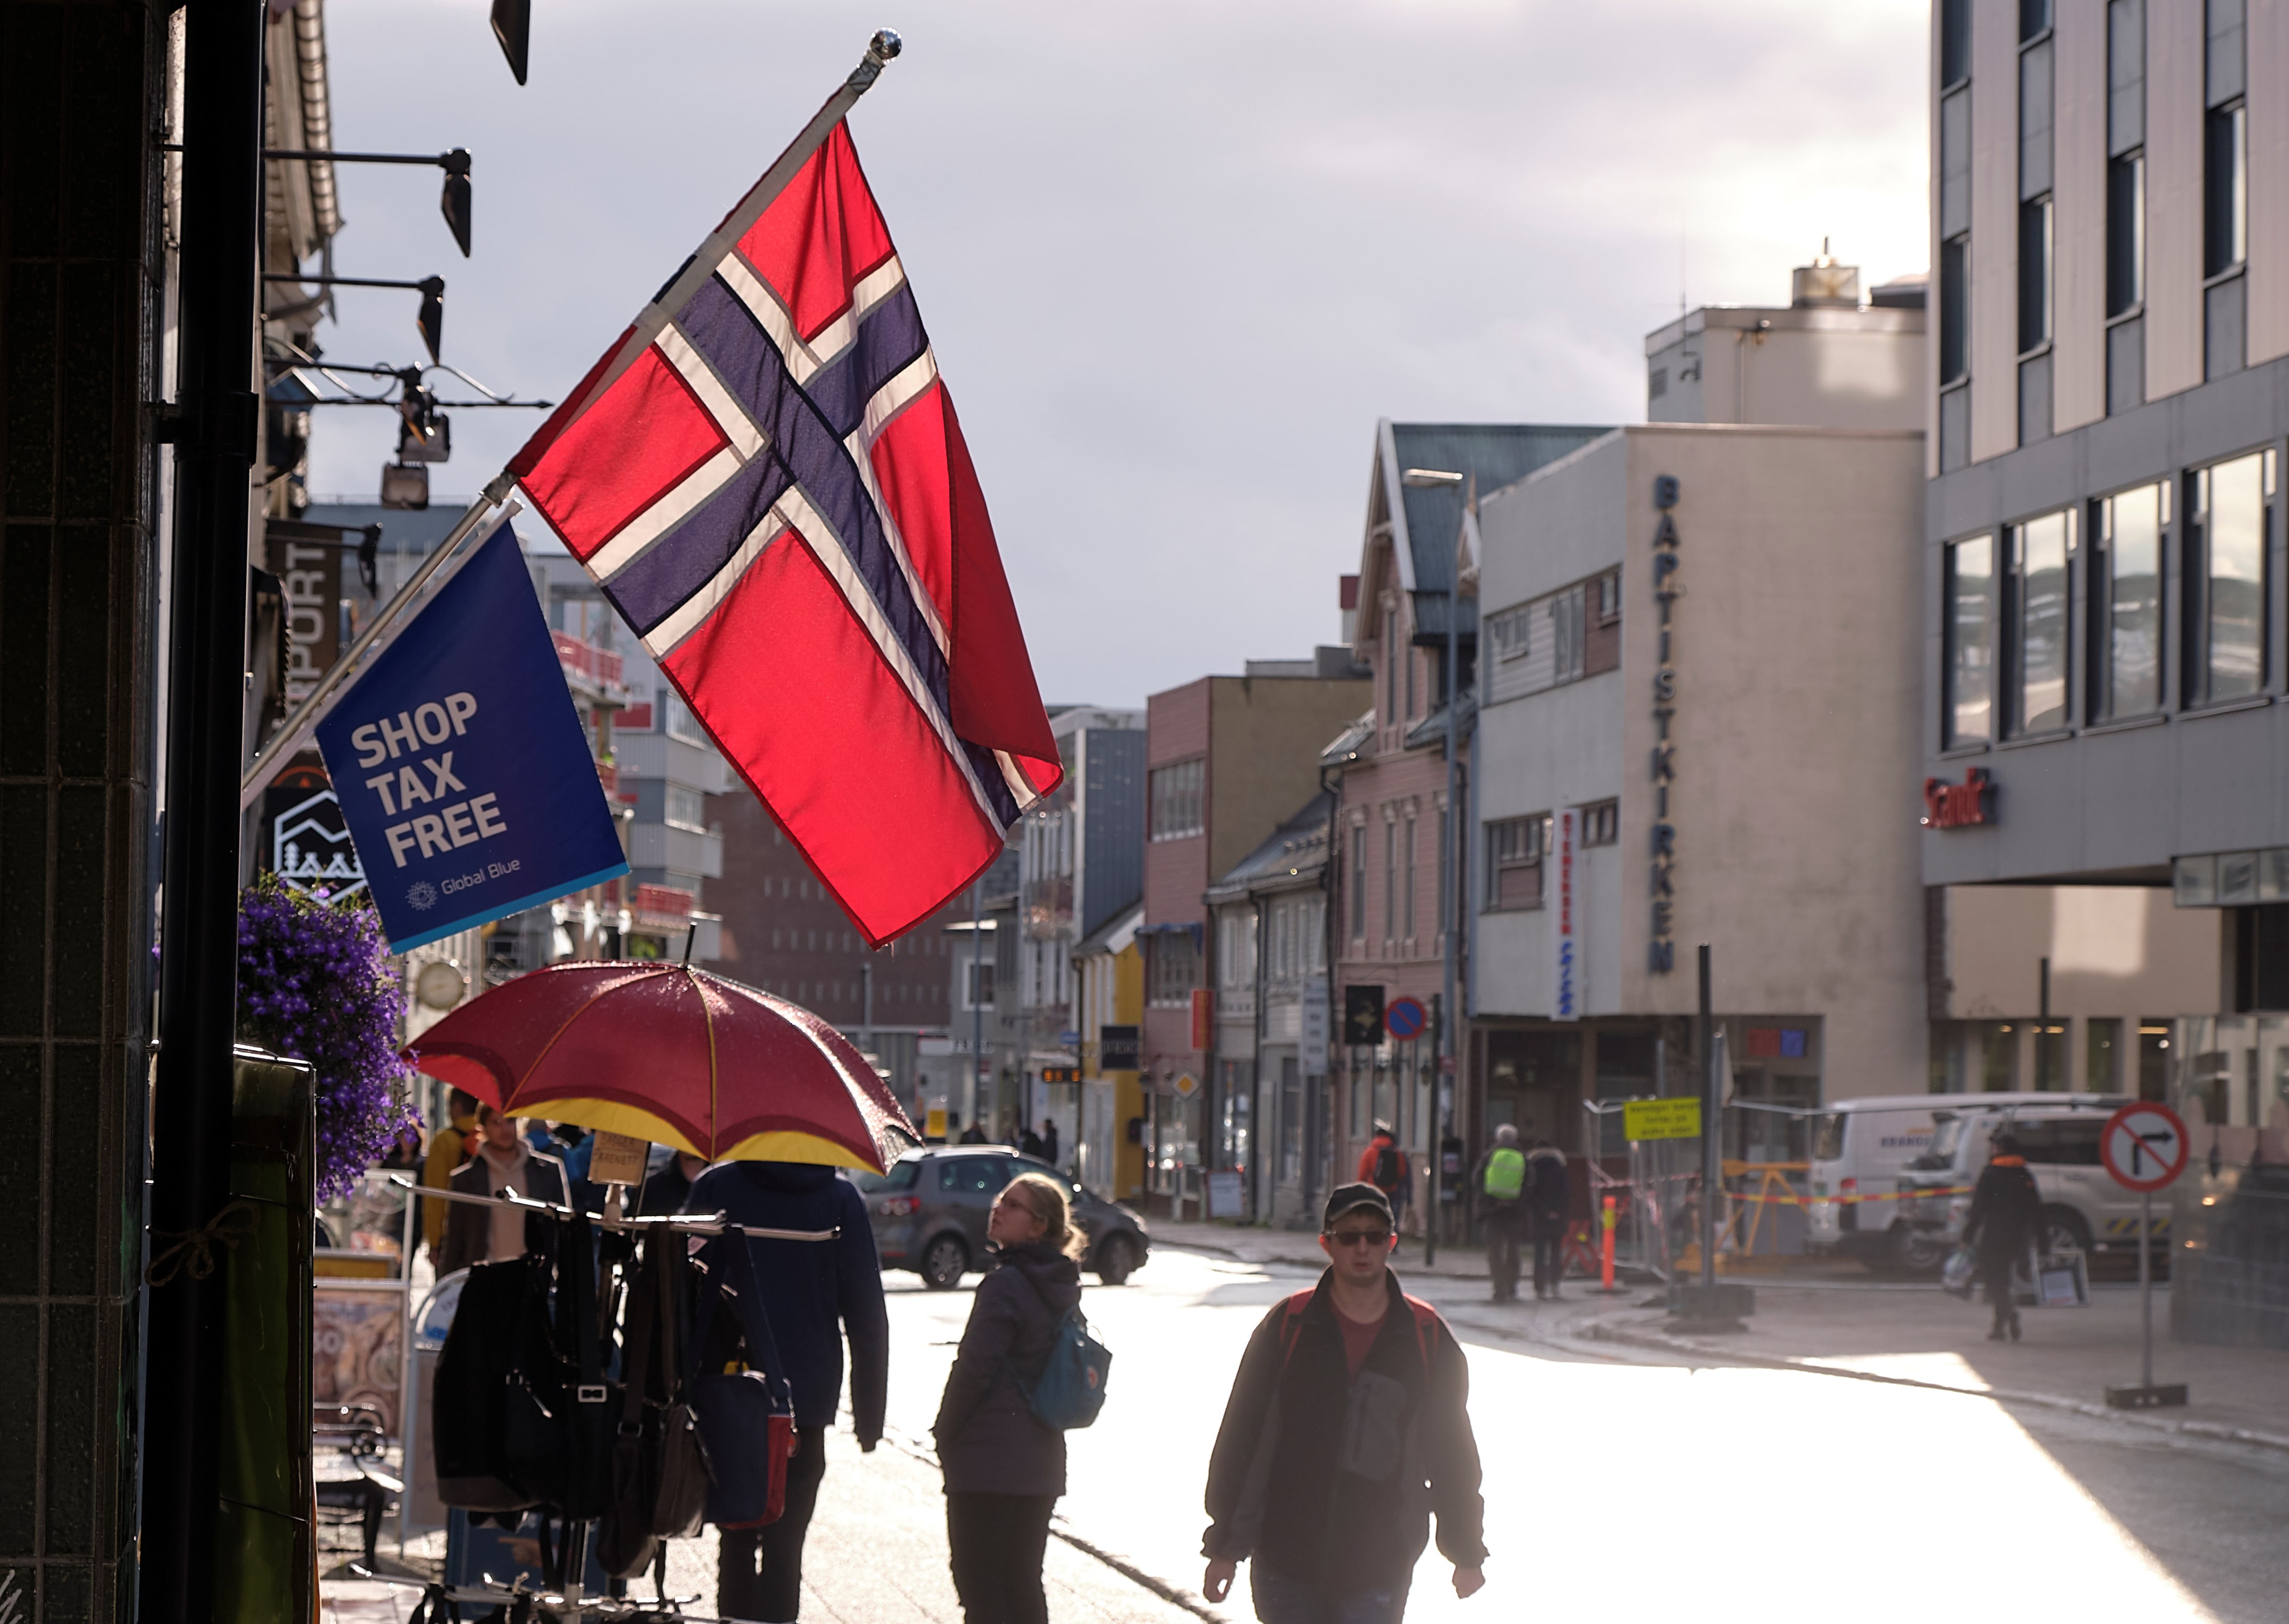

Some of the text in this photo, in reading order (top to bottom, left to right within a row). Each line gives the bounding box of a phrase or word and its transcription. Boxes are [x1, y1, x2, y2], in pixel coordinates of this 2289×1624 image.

[351, 692, 478, 769] SHOP
[1650, 475, 1680, 975] BAPTISTKIRKEN
[365, 750, 466, 816] TAX
[384, 792, 508, 869] FREE
[441, 859, 521, 895] Global Blue
